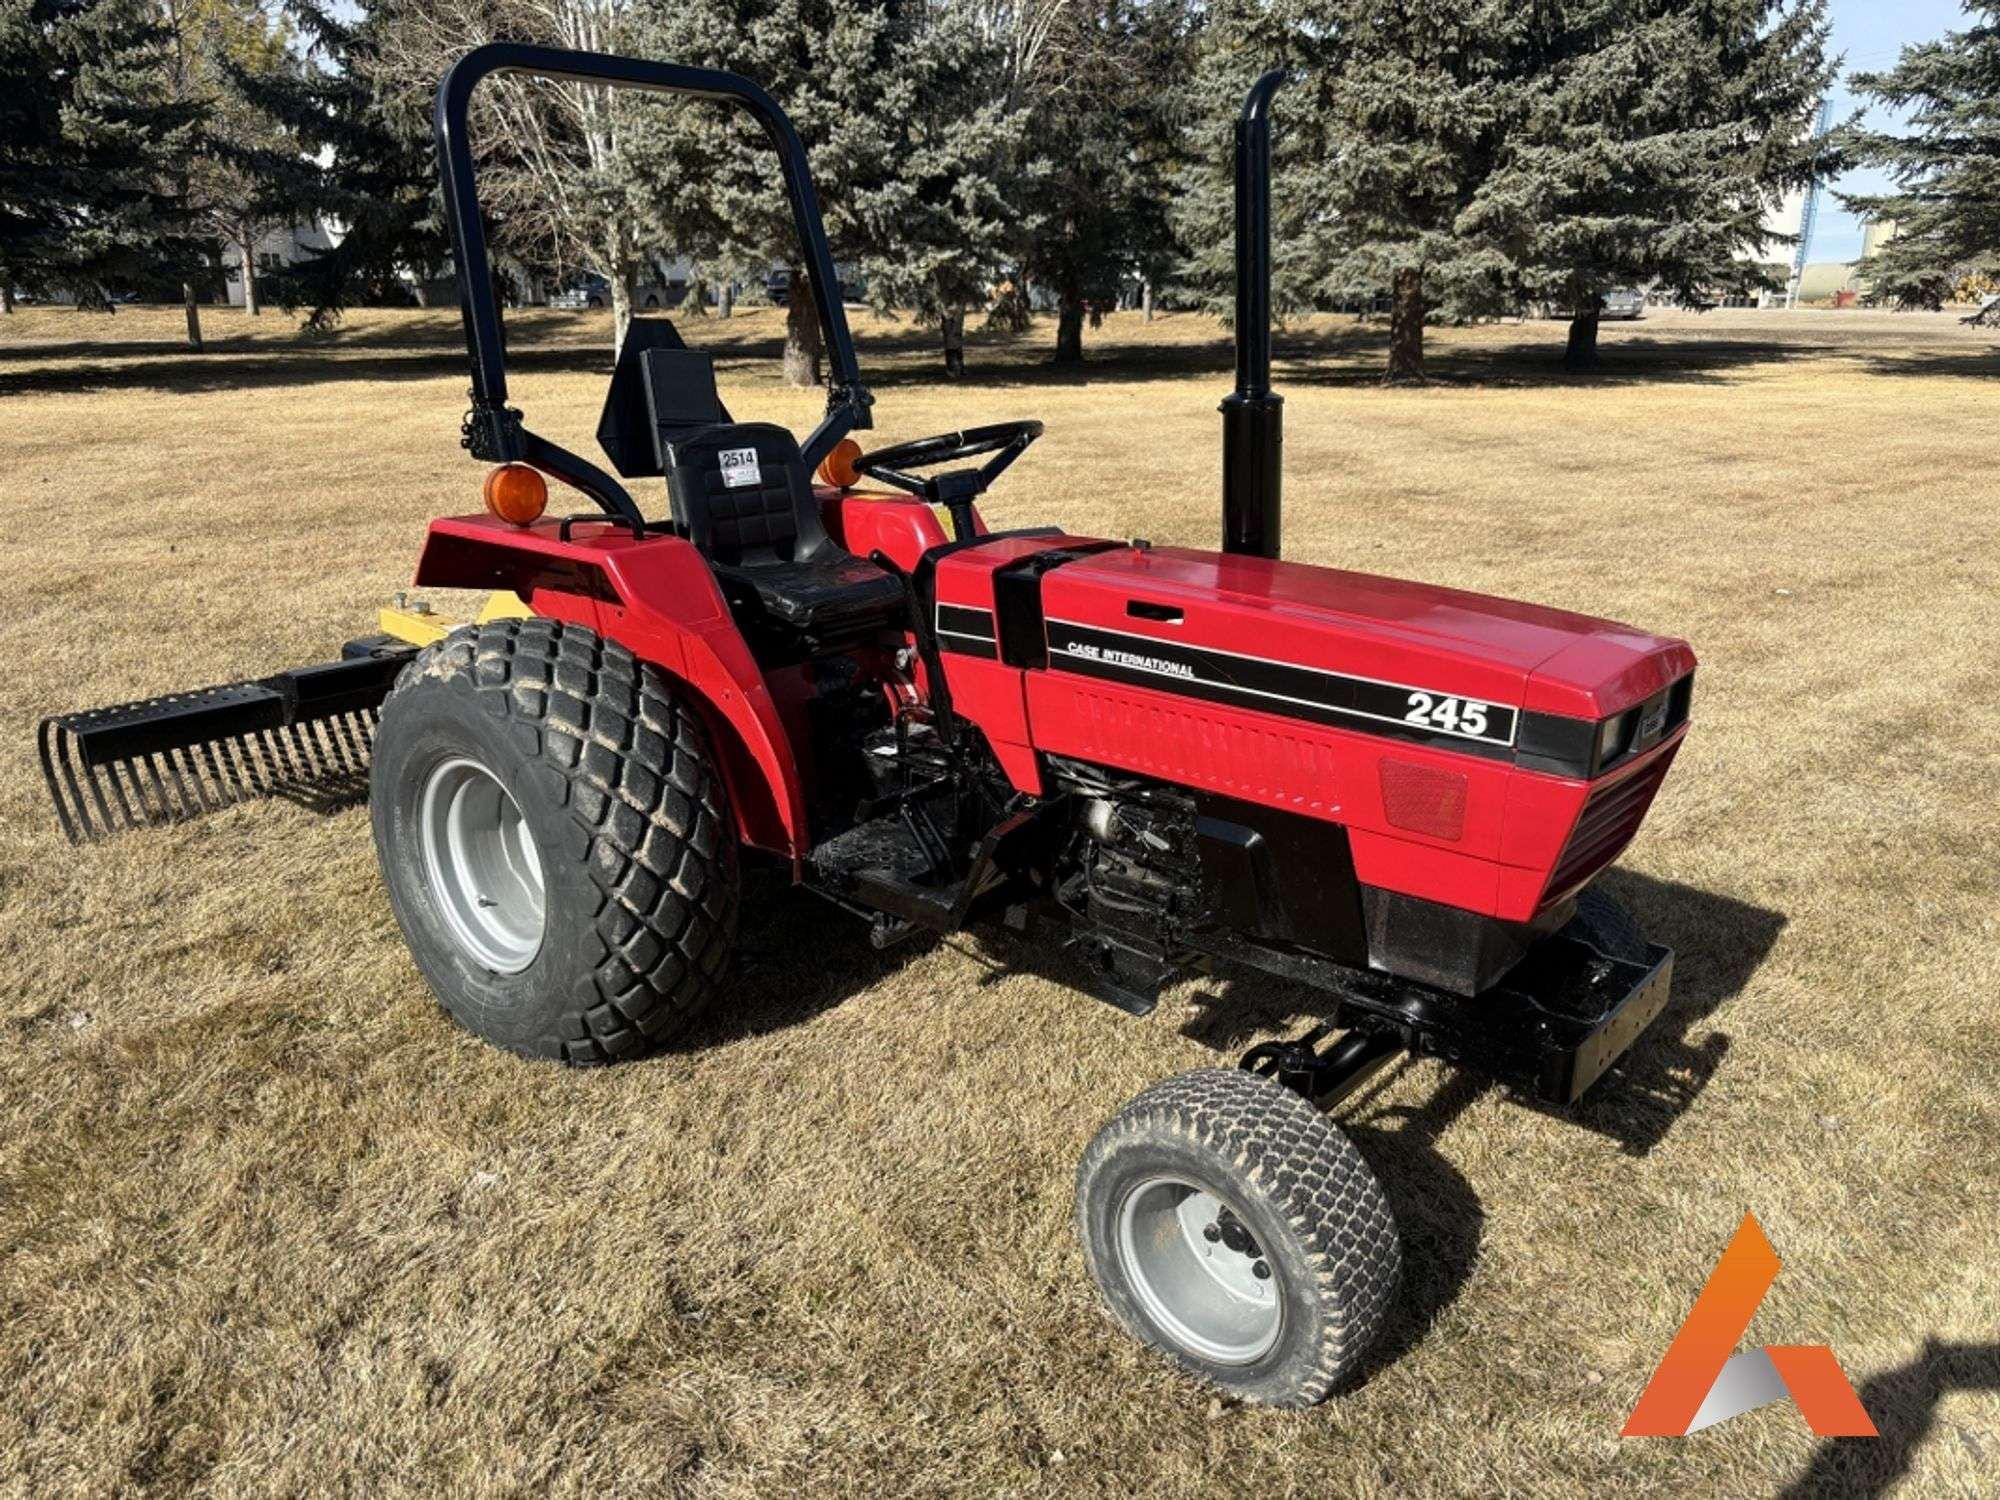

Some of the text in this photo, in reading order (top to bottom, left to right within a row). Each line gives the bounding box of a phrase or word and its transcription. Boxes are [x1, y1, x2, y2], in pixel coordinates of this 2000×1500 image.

[723, 451, 753, 468] 2514
[1067, 642, 1194, 678] CASE INTERNATIONAL
[1404, 691, 1488, 735] 245
